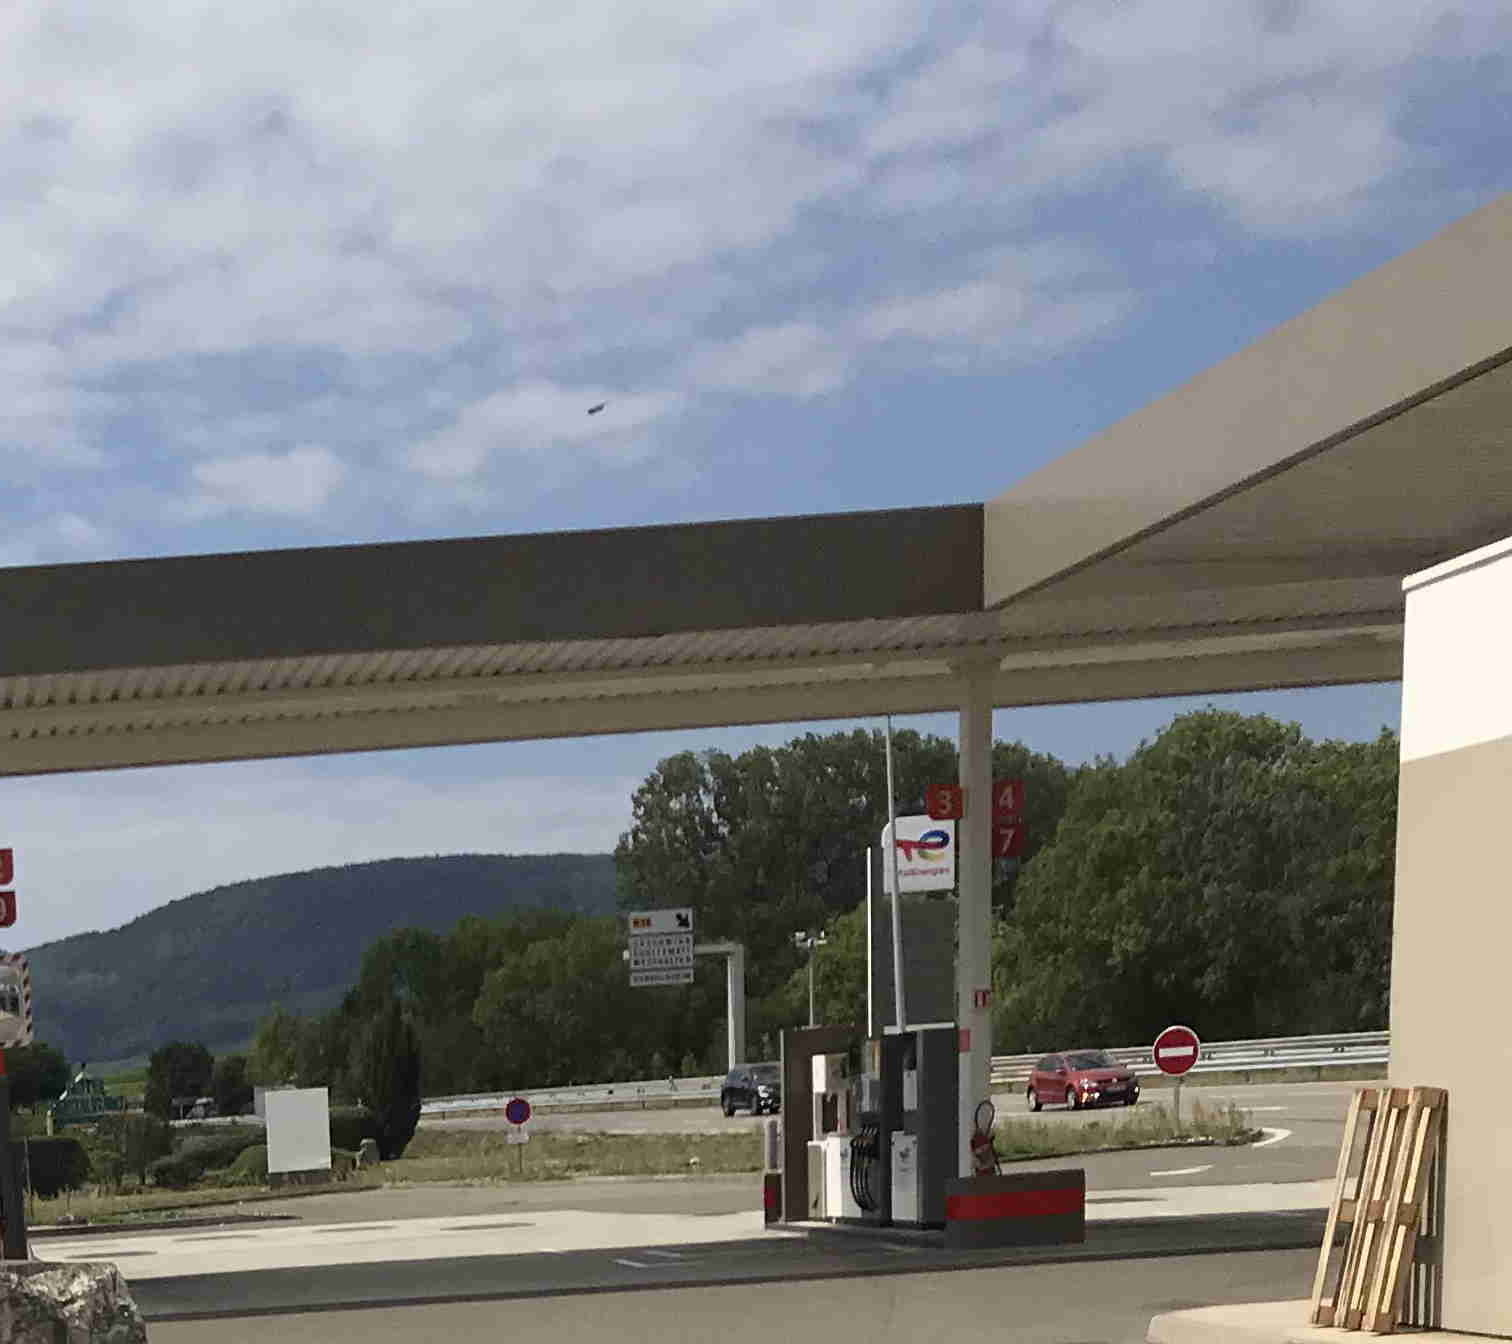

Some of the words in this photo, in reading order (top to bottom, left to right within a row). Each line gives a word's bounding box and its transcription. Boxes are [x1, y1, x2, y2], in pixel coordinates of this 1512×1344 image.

[936, 788, 953, 814] 3
[999, 784, 1015, 810] 4
[999, 827, 1016, 856] 7
